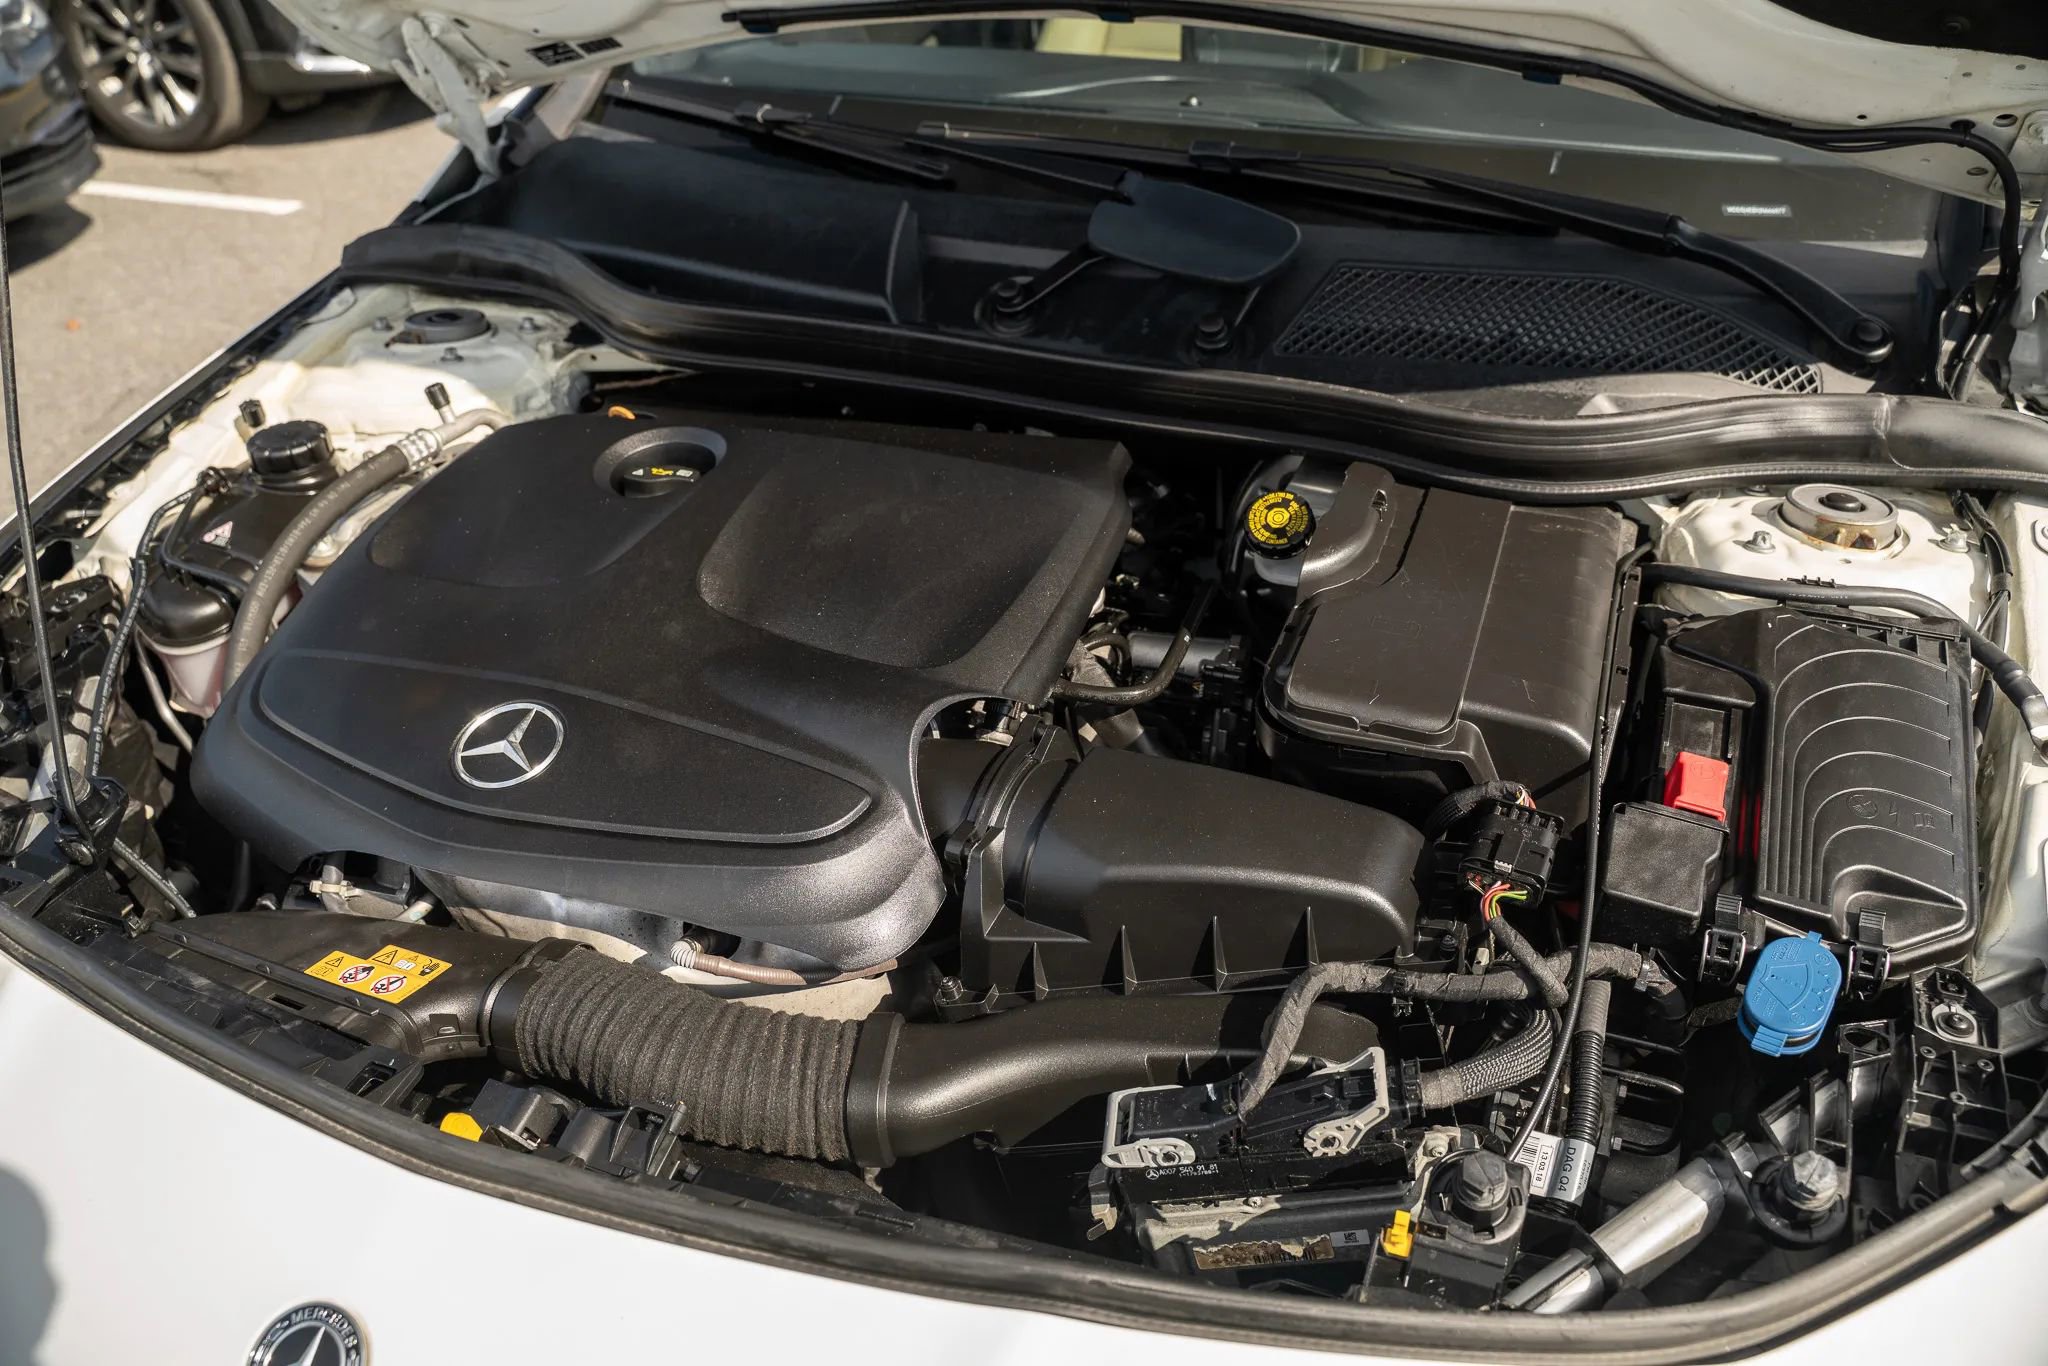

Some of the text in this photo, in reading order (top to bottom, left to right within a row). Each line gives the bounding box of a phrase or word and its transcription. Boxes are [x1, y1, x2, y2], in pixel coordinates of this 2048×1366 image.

[1558, 1146, 1577, 1192] DAG Q4
[290, 1306, 358, 1347] MERCEDES
